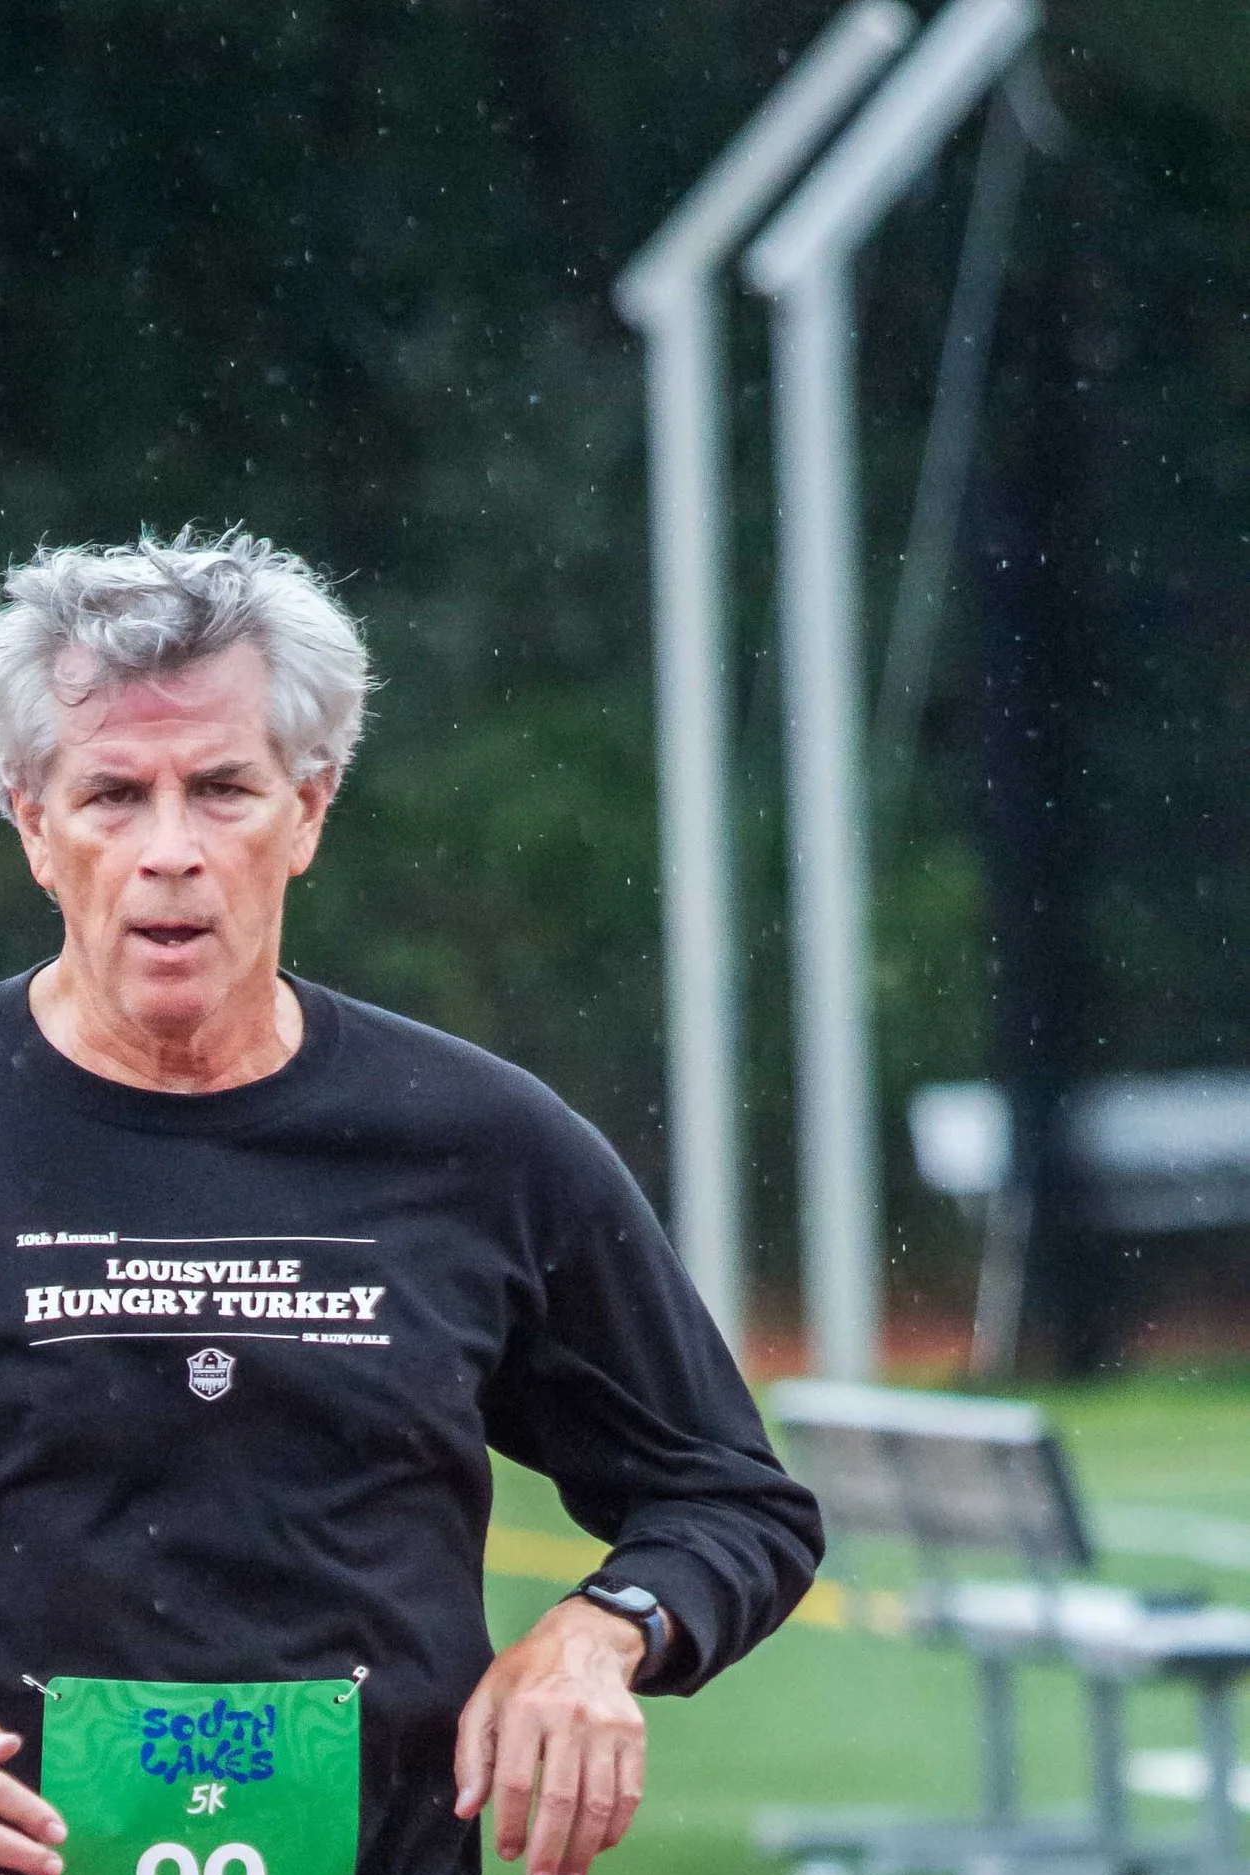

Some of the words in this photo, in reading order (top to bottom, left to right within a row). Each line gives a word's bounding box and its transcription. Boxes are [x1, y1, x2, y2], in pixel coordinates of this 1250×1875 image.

[16, 1232, 54, 1247] 10th
[54, 1231, 118, 1244] Annual
[106, 1259, 302, 1284] LOUISVILLE
[25, 1286, 208, 1322] HUNGRY
[213, 1287, 386, 1321] TURKEY
[143, 1699, 276, 1748] SOUTH
[141, 1741, 274, 1784] LAKES
[186, 1783, 227, 1815] 5K
